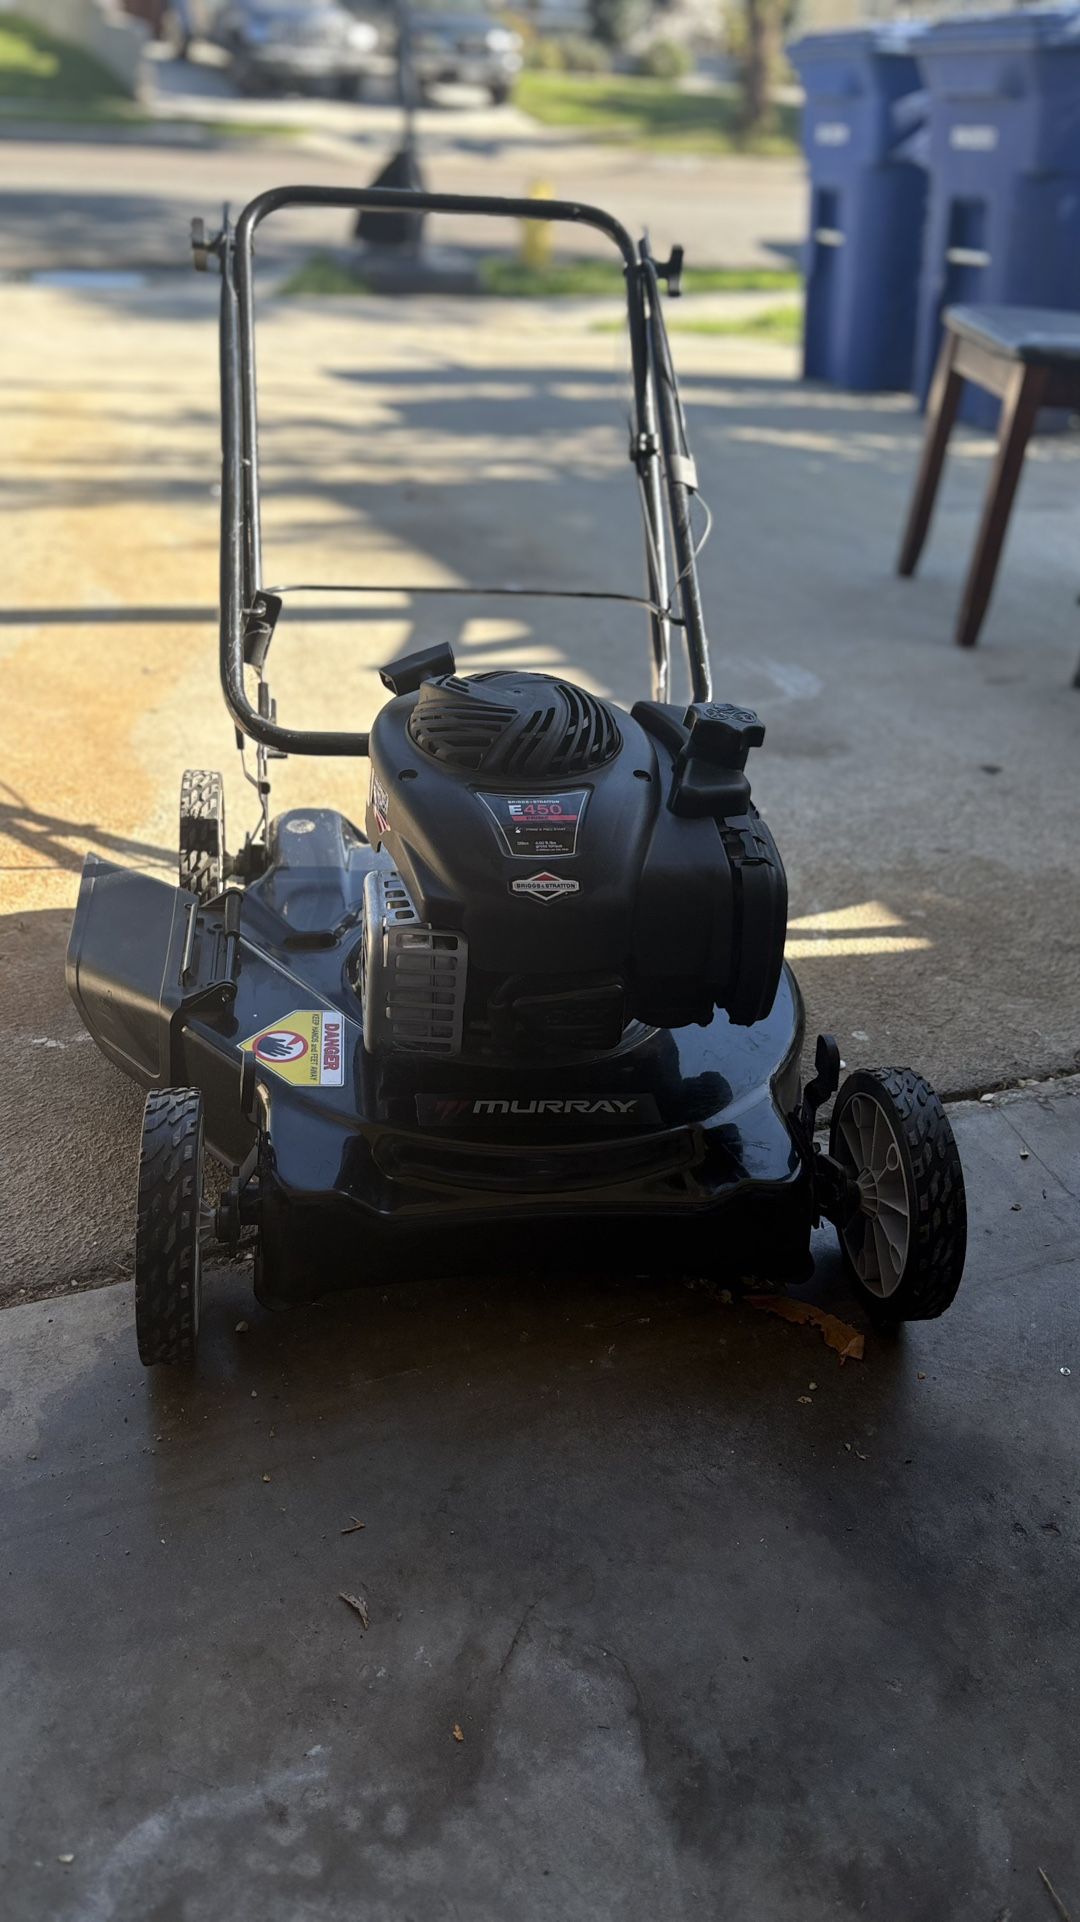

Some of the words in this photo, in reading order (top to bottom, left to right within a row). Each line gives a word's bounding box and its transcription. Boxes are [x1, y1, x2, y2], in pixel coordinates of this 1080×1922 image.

[508, 804, 562, 815] E450
[312, 1013, 320, 1026] KEEP
[311, 1026, 319, 1043] HANDS
[323, 1023, 340, 1070] DANGER
[310, 1053, 318, 1065] FEET
[309, 1065, 318, 1081] AWAY
[472, 1099, 639, 1114] MURRAY
